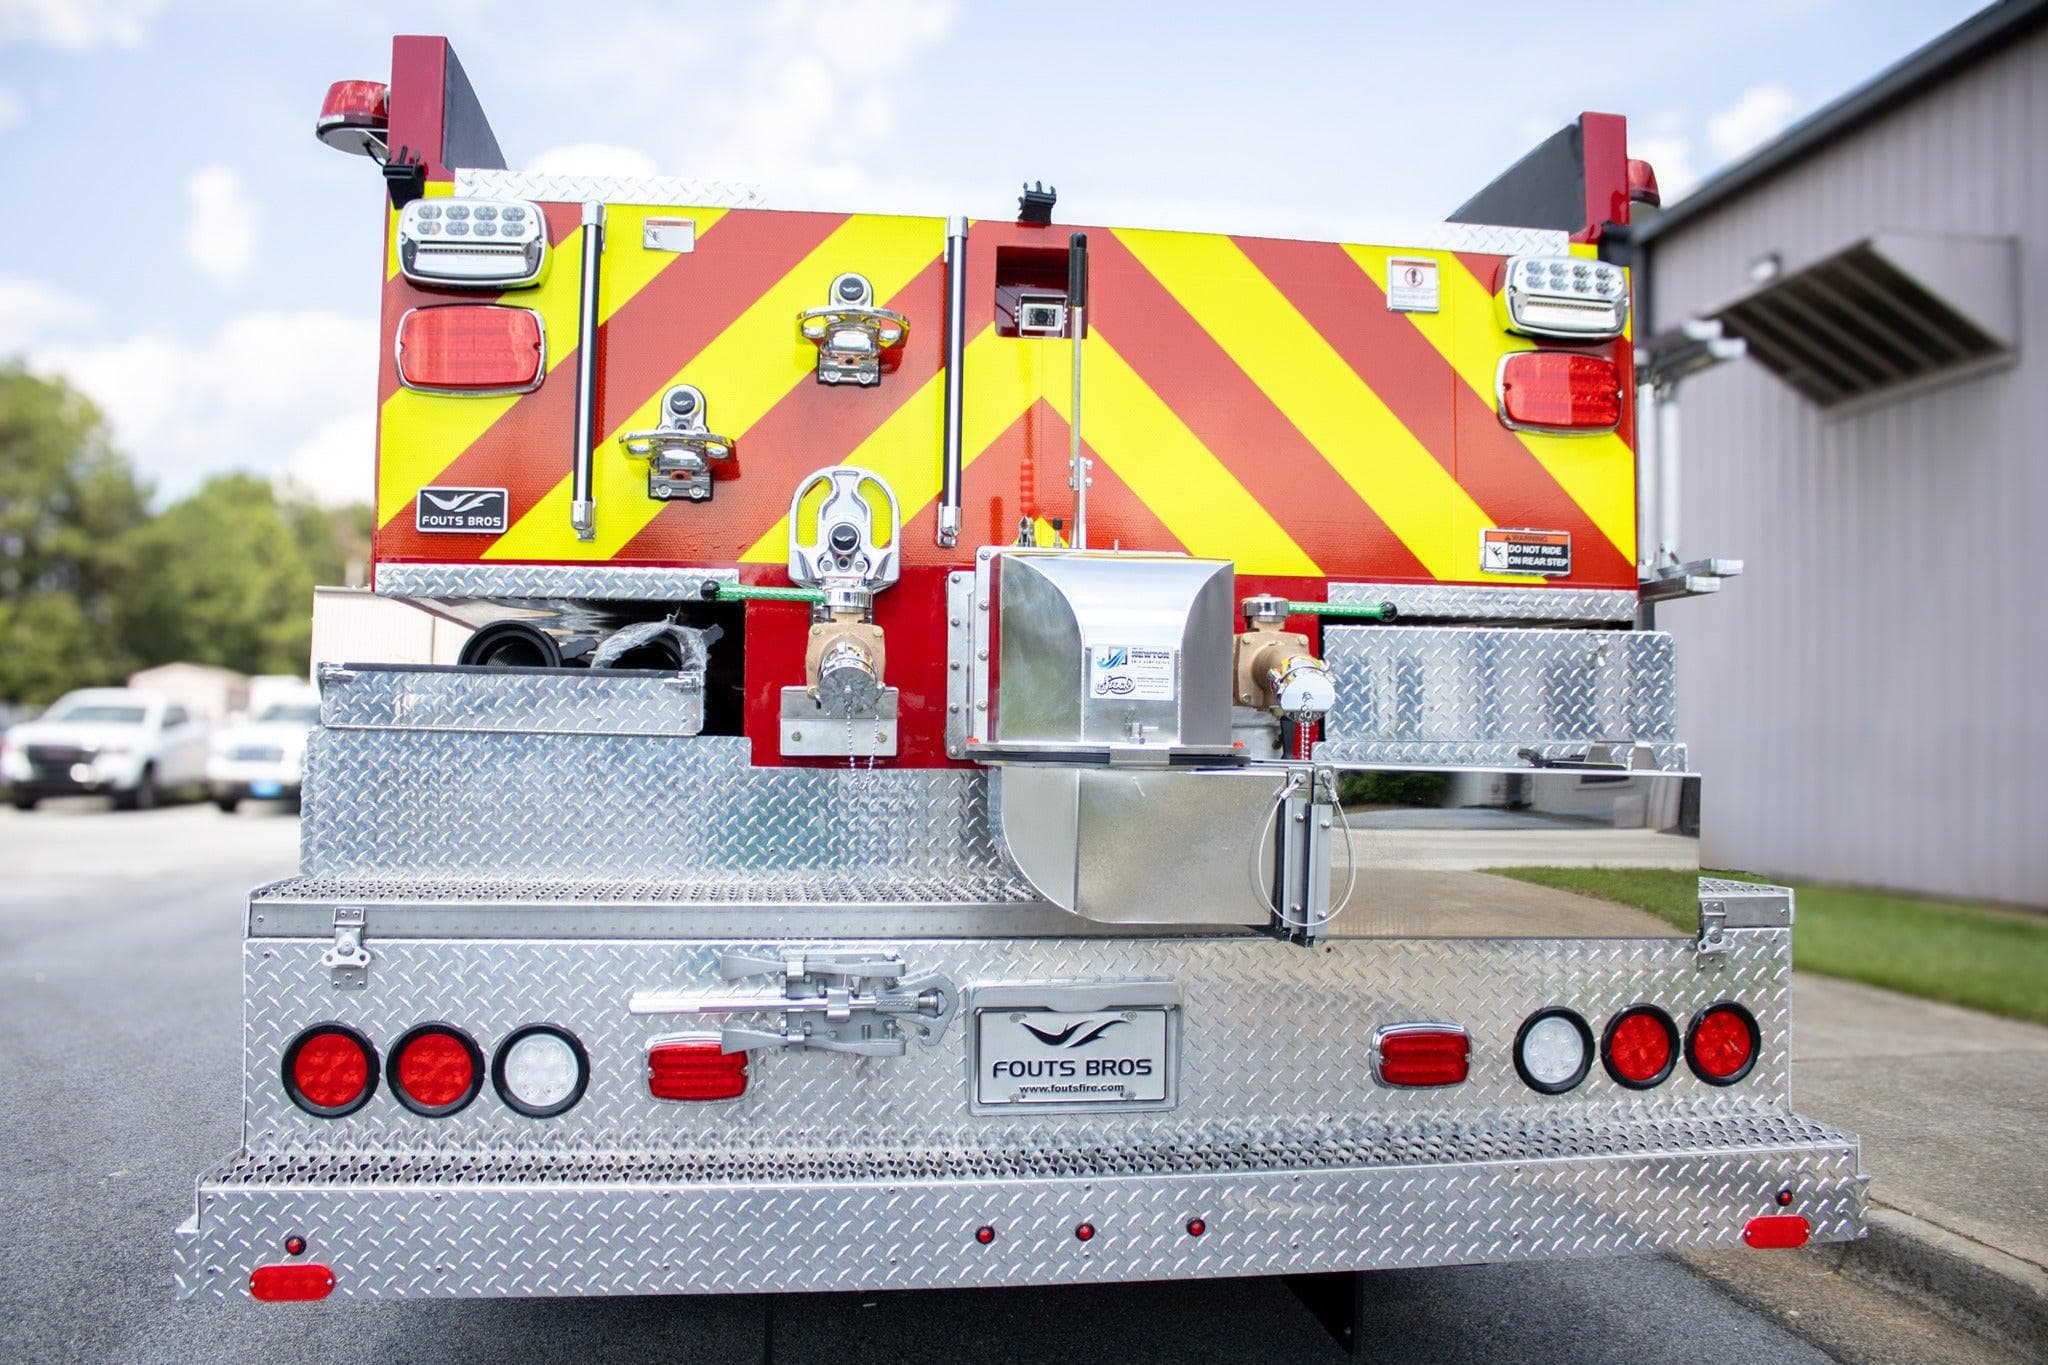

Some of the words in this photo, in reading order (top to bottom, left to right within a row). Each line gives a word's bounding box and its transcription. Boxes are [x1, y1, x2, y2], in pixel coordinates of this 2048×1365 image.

[422, 515, 463, 526] FOUTS
[468, 516, 501, 526] BROS
[1512, 535, 1548, 543] WARNING
[1509, 544, 1521, 553] DO
[1522, 545, 1540, 554] NOT
[1541, 546, 1562, 555] RIDE
[1509, 556, 1521, 565] ON
[1522, 557, 1546, 566] REAR
[1546, 558, 1568, 567] STEP
[993, 1059, 1076, 1078] FOUTS
[1086, 1058, 1152, 1076] BROS
[1019, 1083, 1124, 1093] www.foutsfire.com
